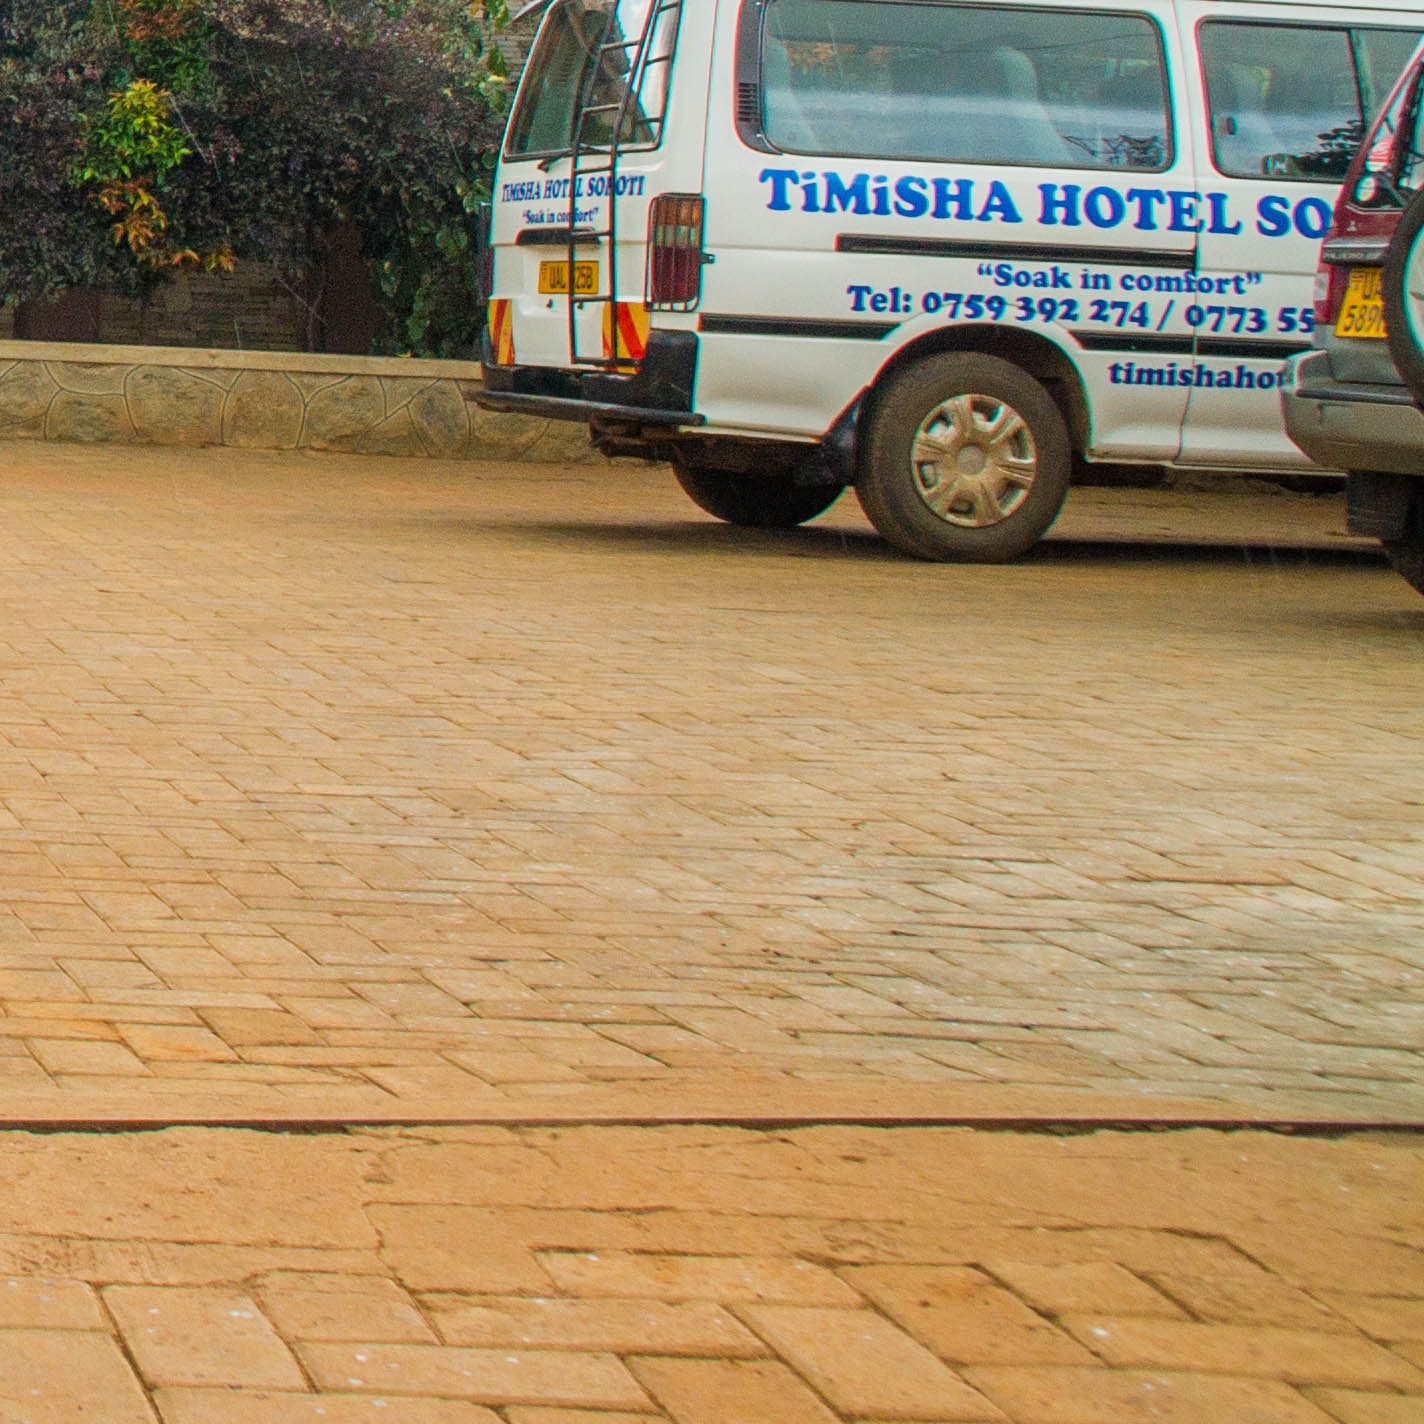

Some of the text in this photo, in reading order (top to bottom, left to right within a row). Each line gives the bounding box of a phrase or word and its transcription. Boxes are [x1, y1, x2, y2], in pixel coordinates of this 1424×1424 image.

[543, 178, 583, 198] HOTL
[759, 168, 1023, 223] TiMiSHA
[1038, 183, 1243, 235] HOTEL
[570, 265, 593, 289] 25B
[1081, 268, 1112, 290] in
[847, 285, 912, 314] Tel:
[921, 291, 1008, 321] 0759
[1015, 296, 1080, 323] 392
[1088, 298, 1151, 328] 274
[1184, 304, 1269, 334] 0773
